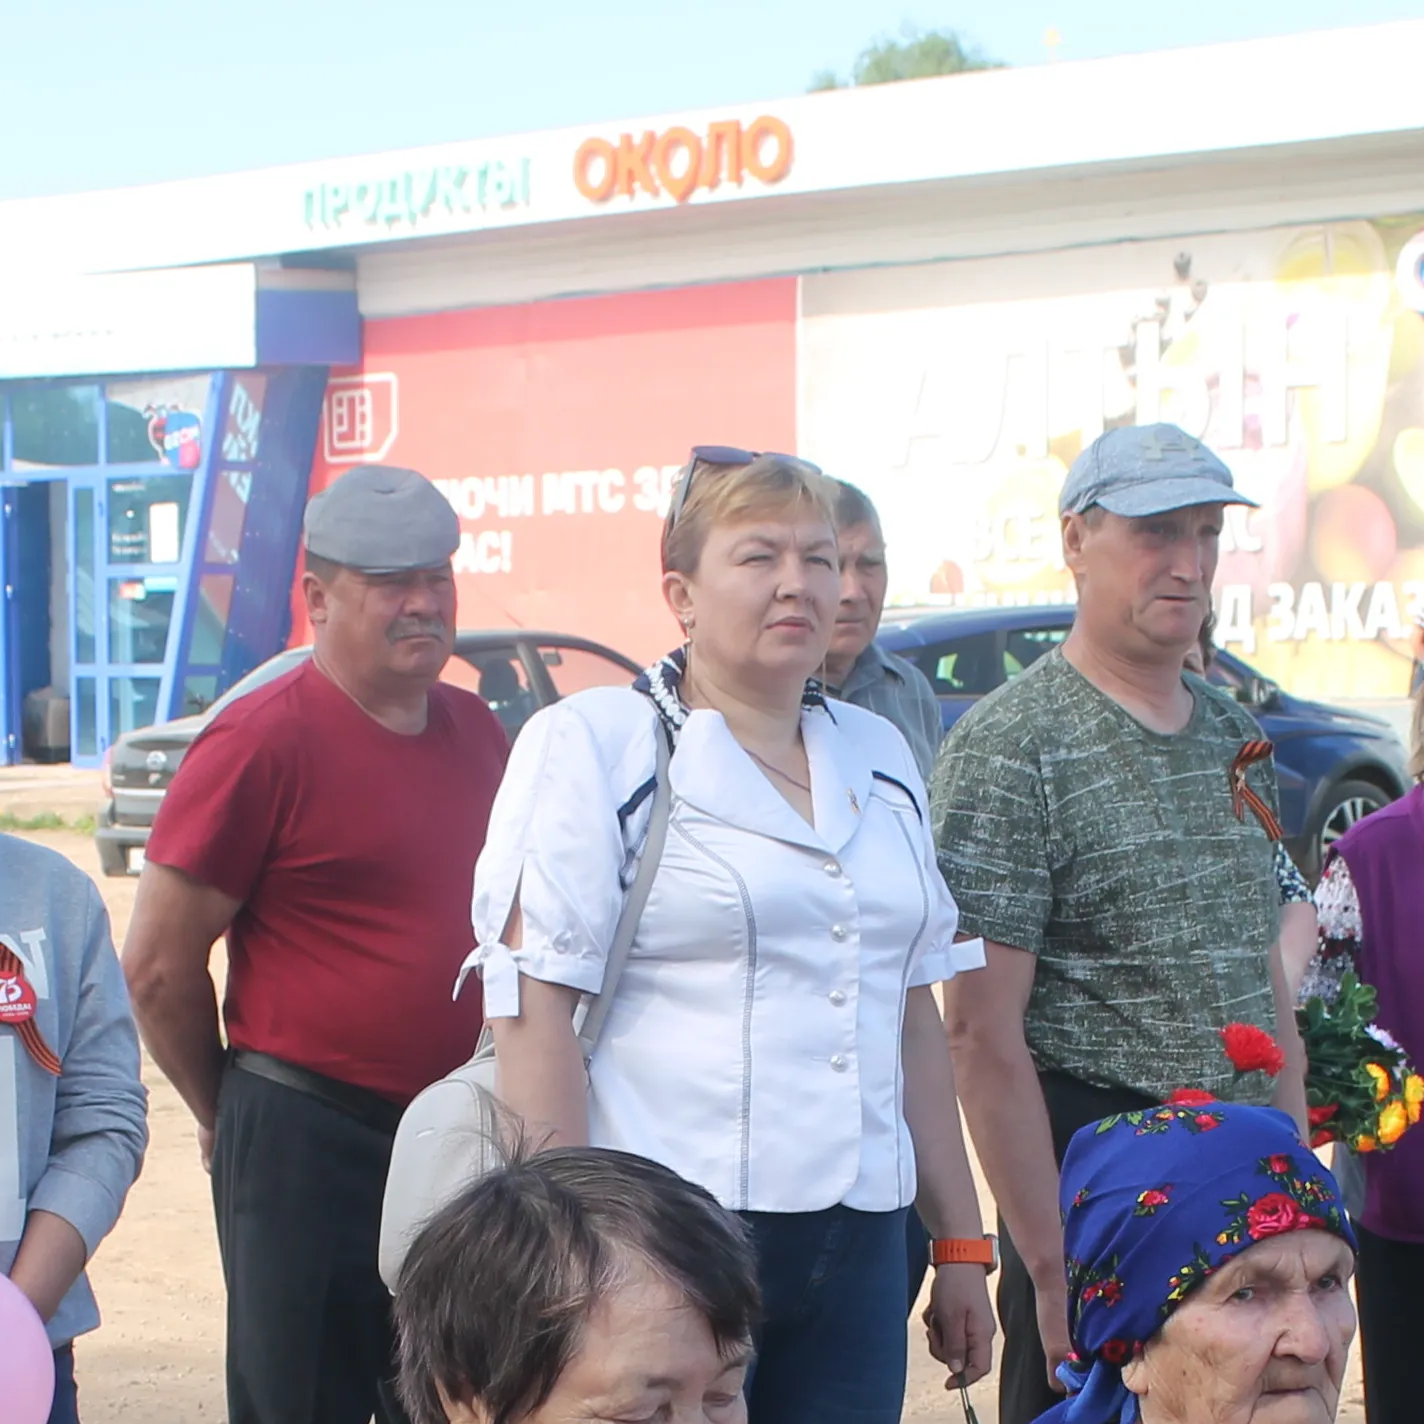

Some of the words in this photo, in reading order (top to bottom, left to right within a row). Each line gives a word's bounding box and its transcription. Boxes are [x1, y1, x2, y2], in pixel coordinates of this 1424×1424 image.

[302, 156, 532, 232] ПРОДУКТЫ
[573, 115, 793, 204] ОКОЛО
[543, 468, 626, 517] МТС
[453, 529, 512, 574] АС!
